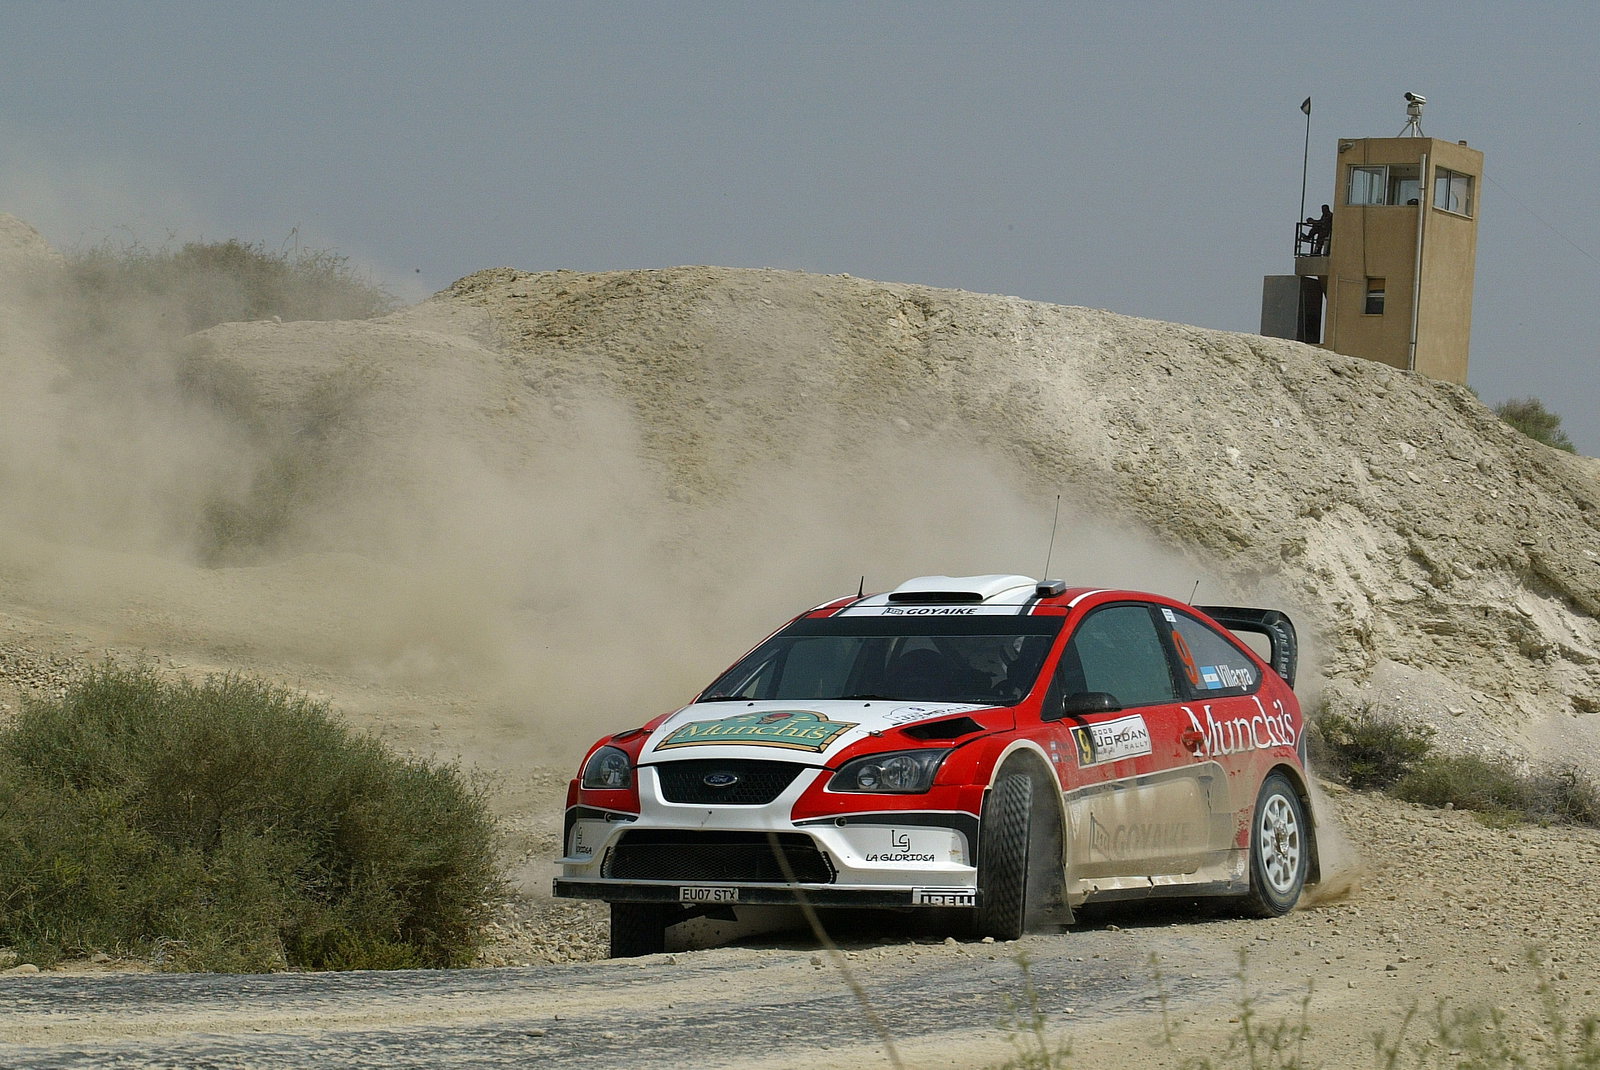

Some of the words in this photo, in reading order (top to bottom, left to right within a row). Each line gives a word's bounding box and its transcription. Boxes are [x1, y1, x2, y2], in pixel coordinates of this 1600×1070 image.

[1172, 630, 1199, 685] 9
[1215, 664, 1254, 691] Villagra
[1078, 729, 1092, 764] 9
[1097, 728, 1147, 747] JORDAN
[1124, 741, 1148, 750] RALLY
[865, 854, 878, 862] LA
[880, 854, 935, 862] GLORIOSA
[682, 888, 711, 900] EU07
[714, 889, 735, 900] STX
[912, 888, 976, 907] PIRELLI
